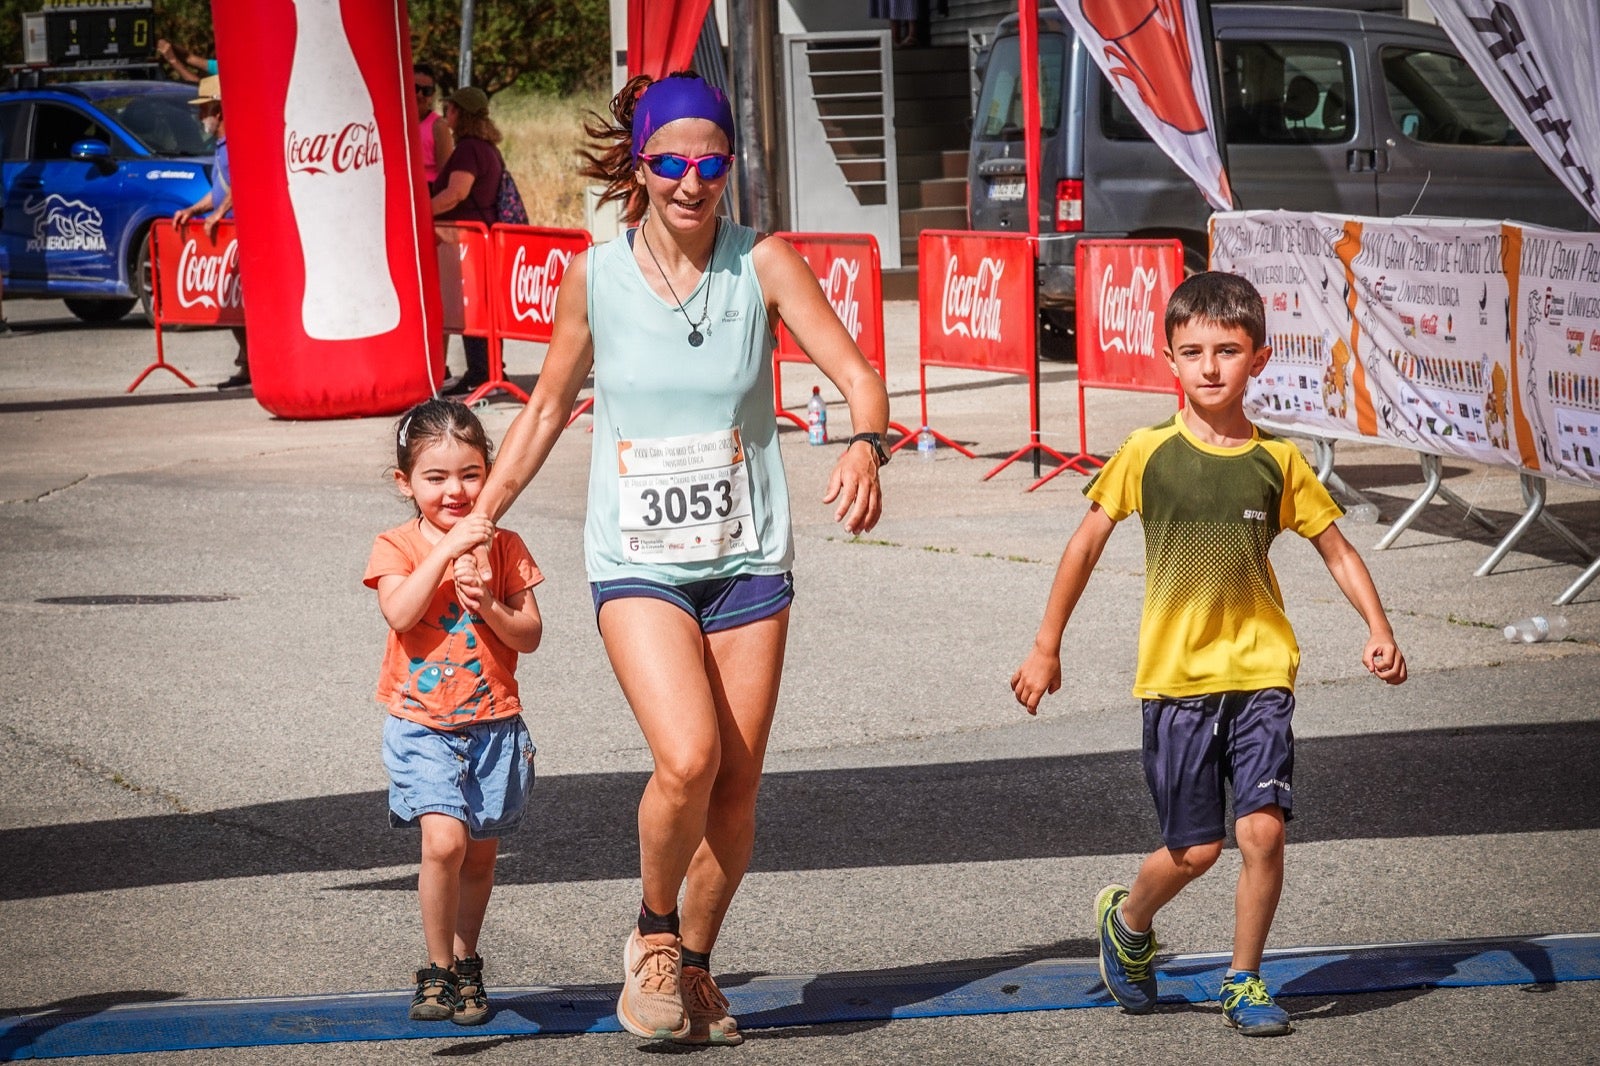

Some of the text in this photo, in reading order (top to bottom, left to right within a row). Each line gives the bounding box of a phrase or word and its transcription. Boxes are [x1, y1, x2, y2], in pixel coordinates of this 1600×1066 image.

[287, 121, 379, 175] Coca-Cola
[1384, 233, 1409, 271] GRAN
[1407, 235, 1440, 273] PREMIO
[1440, 242, 1453, 273] DE
[1453, 236, 1482, 274] FONDO
[1484, 234, 1510, 274] 2022
[1520, 238, 1600, 283] XXXV GRAN PRE
[942, 255, 1004, 343] Coca-Cola
[1099, 263, 1158, 358] Coca-Cola
[1397, 280, 1461, 307] UNIVERSO LORCA
[640, 479, 733, 526] 3053
